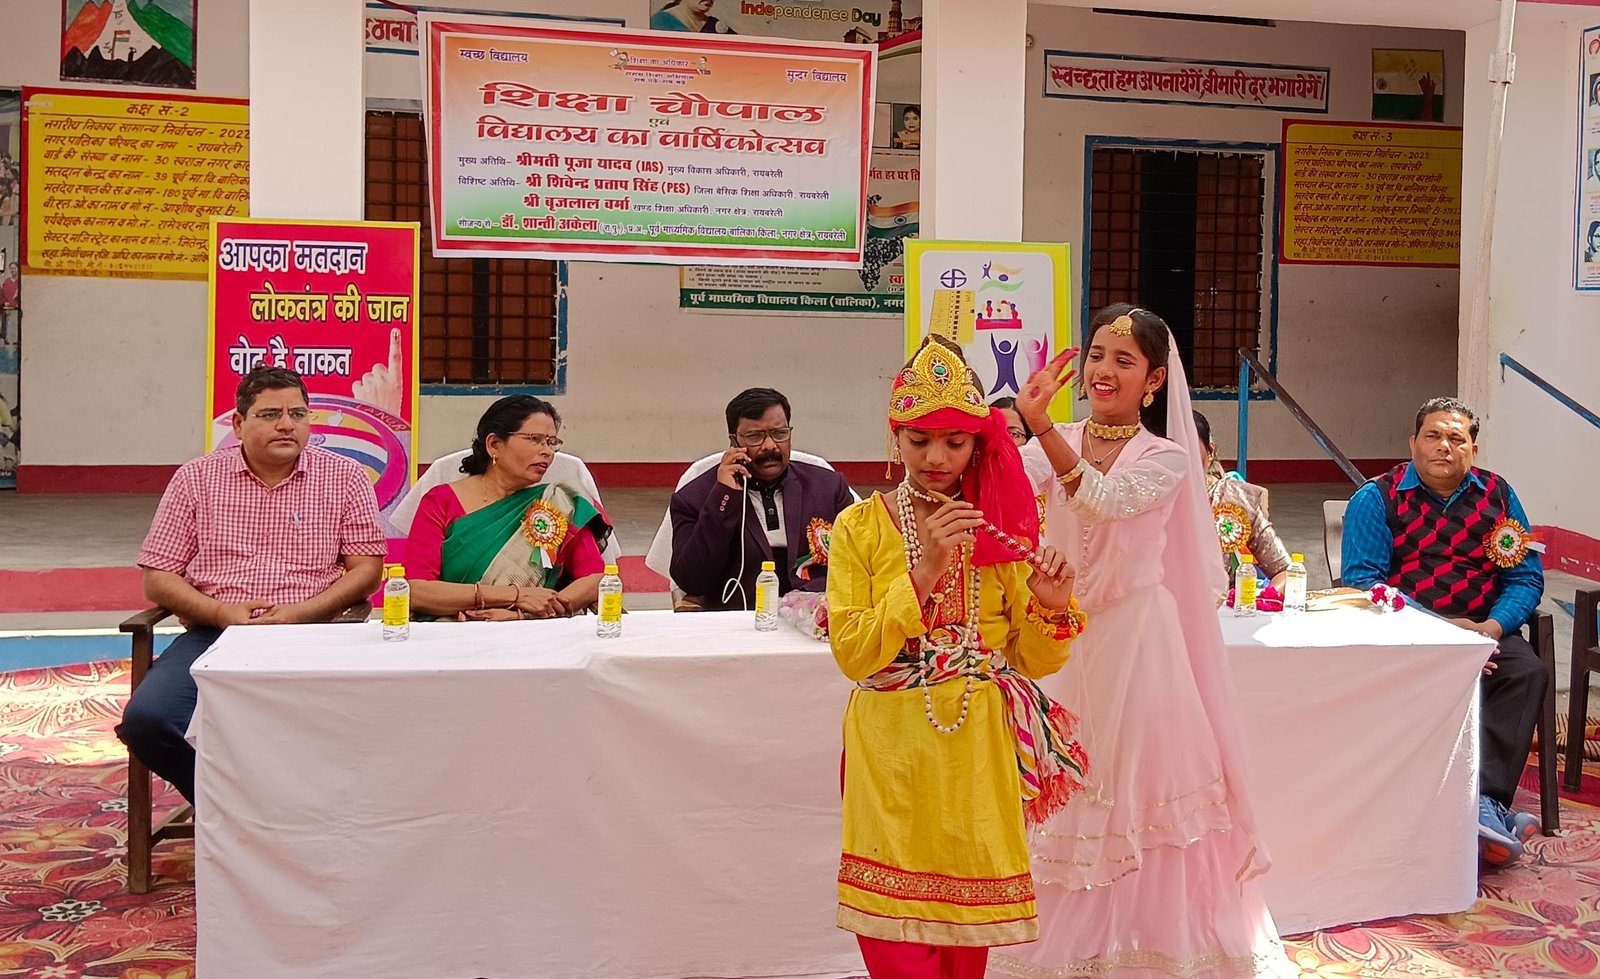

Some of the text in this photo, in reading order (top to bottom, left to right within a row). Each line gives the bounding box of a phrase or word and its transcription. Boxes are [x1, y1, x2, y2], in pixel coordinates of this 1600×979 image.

[741, 1, 881, 26] Independence Day
[460, 49, 528, 63] स्वच्छ विद्यालय
[786, 70, 847, 83] सुन्दर विद्यालय
[1115, 70, 1137, 92] हम
[1203, 69, 1246, 98] बीमारी
[1249, 76, 1267, 104] दूर
[127, 103, 154, 116] कक्ष
[479, 82, 825, 122] शिक्षा चौपाल
[45, 117, 82, 130] नगरीय
[119, 123, 160, 133] सामान्य
[162, 123, 207, 136] निर्वाचन
[649, 117, 671, 127] एवं
[476, 115, 827, 155] विद्यालय का वार्षिकोत्सव
[63, 147, 77, 159] की
[154, 155, 169, 165] 30
[174, 156, 206, 167] स्वराज
[207, 159, 232, 170] नगर
[156, 141, 178, 150] नाम
[197, 142, 243, 154] रायबरेली
[45, 166, 84, 179] मतदान
[173, 170, 188, 184] पूर्व
[458, 156, 477, 167] मुख्य
[516, 152, 560, 167] श्रीमती
[565, 157, 593, 172] पूजा
[597, 158, 632, 171] यादव
[636, 160, 664, 174] (IAS)
[667, 165, 684, 176] मुख्य
[688, 165, 712, 175] विकास
[752, 168, 783, 179] रायबरेली
[885, 170, 896, 180] हर
[897, 170, 908, 180] घर
[458, 176, 486, 186] विशिष्ट
[526, 173, 542, 188] श्री
[547, 174, 589, 189] शिवेन्द्र
[594, 178, 629, 191] प्रताप
[633, 178, 659, 192] सिंह
[661, 181, 690, 195] (PES)
[694, 184, 713, 195] जिला
[741, 188, 759, 198] शिक्षा
[800, 190, 830, 201] रायबरेली
[523, 193, 540, 208] श्री
[604, 196, 630, 210] वर्मा
[633, 203, 652, 212] खण्ड
[655, 203, 674, 213] शिक्षा
[715, 207, 731, 215] नगर
[752, 207, 783, 217] रायबरेली
[502, 214, 519, 229] डॉ.
[523, 216, 555, 230] शान्ती
[559, 216, 598, 231] अकेला
[649, 223, 660, 235] पूर्व
[698, 225, 726, 236] विद्यालय
[730, 225, 755, 237] बालिका
[782, 230, 797, 239] नगर
[817, 230, 846, 241] रायबरेली
[221, 242, 366, 272] आपका मतदान
[250, 282, 410, 323] लोकतंत्र की जान
[690, 291, 706, 305] पूर्व
[708, 293, 755, 304] माध्यमिक
[757, 294, 798, 305] विद्यालय
[800, 295, 828, 306] किला
[270, 336, 289, 370] है
[294, 348, 352, 375] ताकत
